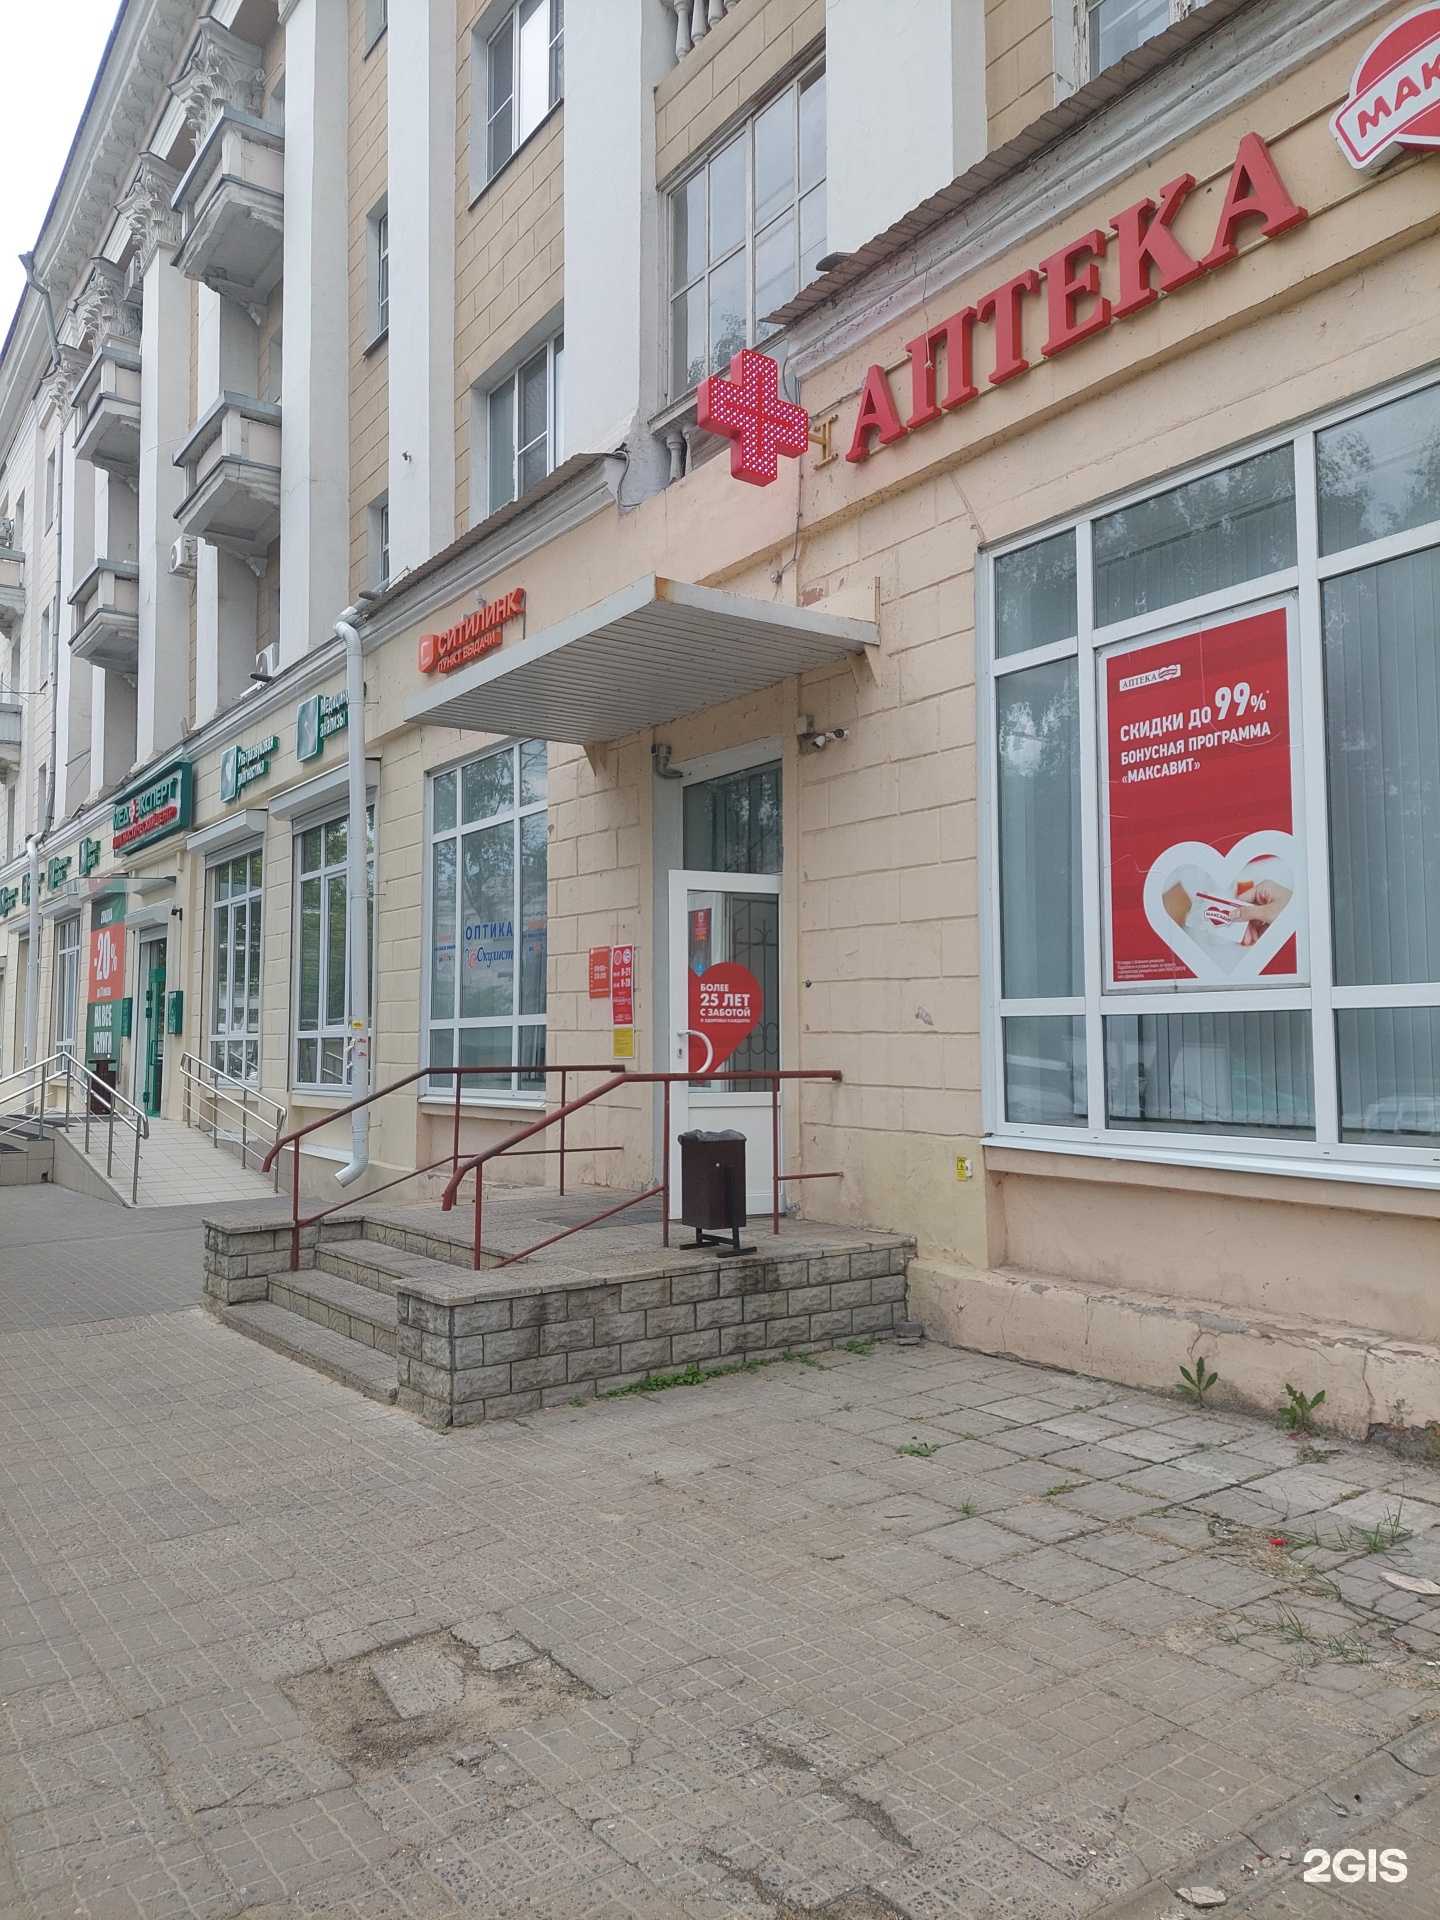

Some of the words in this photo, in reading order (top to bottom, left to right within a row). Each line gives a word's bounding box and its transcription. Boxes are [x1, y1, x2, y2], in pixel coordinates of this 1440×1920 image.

[845, 131, 1309, 464] АПТЕКА
[438, 588, 525, 655] СИТИЛИНК
[438, 652, 461, 673] ПУНКТ
[463, 631, 496, 659] ВЫДАЧИ
[1122, 671, 1158, 689] АПТЕКА
[1120, 712, 1184, 742] СКИДКИ
[1188, 706, 1212, 730] ДО
[1121, 740, 1185, 766] БОНУСНАЯ
[1188, 722, 1271, 752] ПРОГРАММА
[1121, 758, 1201, 784] «МАКСАВИТ»
[465, 921, 513, 940] ОПТИКА
[93, 930, 118, 981] -20%
[700, 983, 729, 992] БОЛЕЕ
[700, 993, 720, 1007] 25
[722, 993, 750, 1007] ЛЕТ
[700, 1008, 706, 1017] С
[708, 1007, 751, 1017] ЗАБОТОЙ
